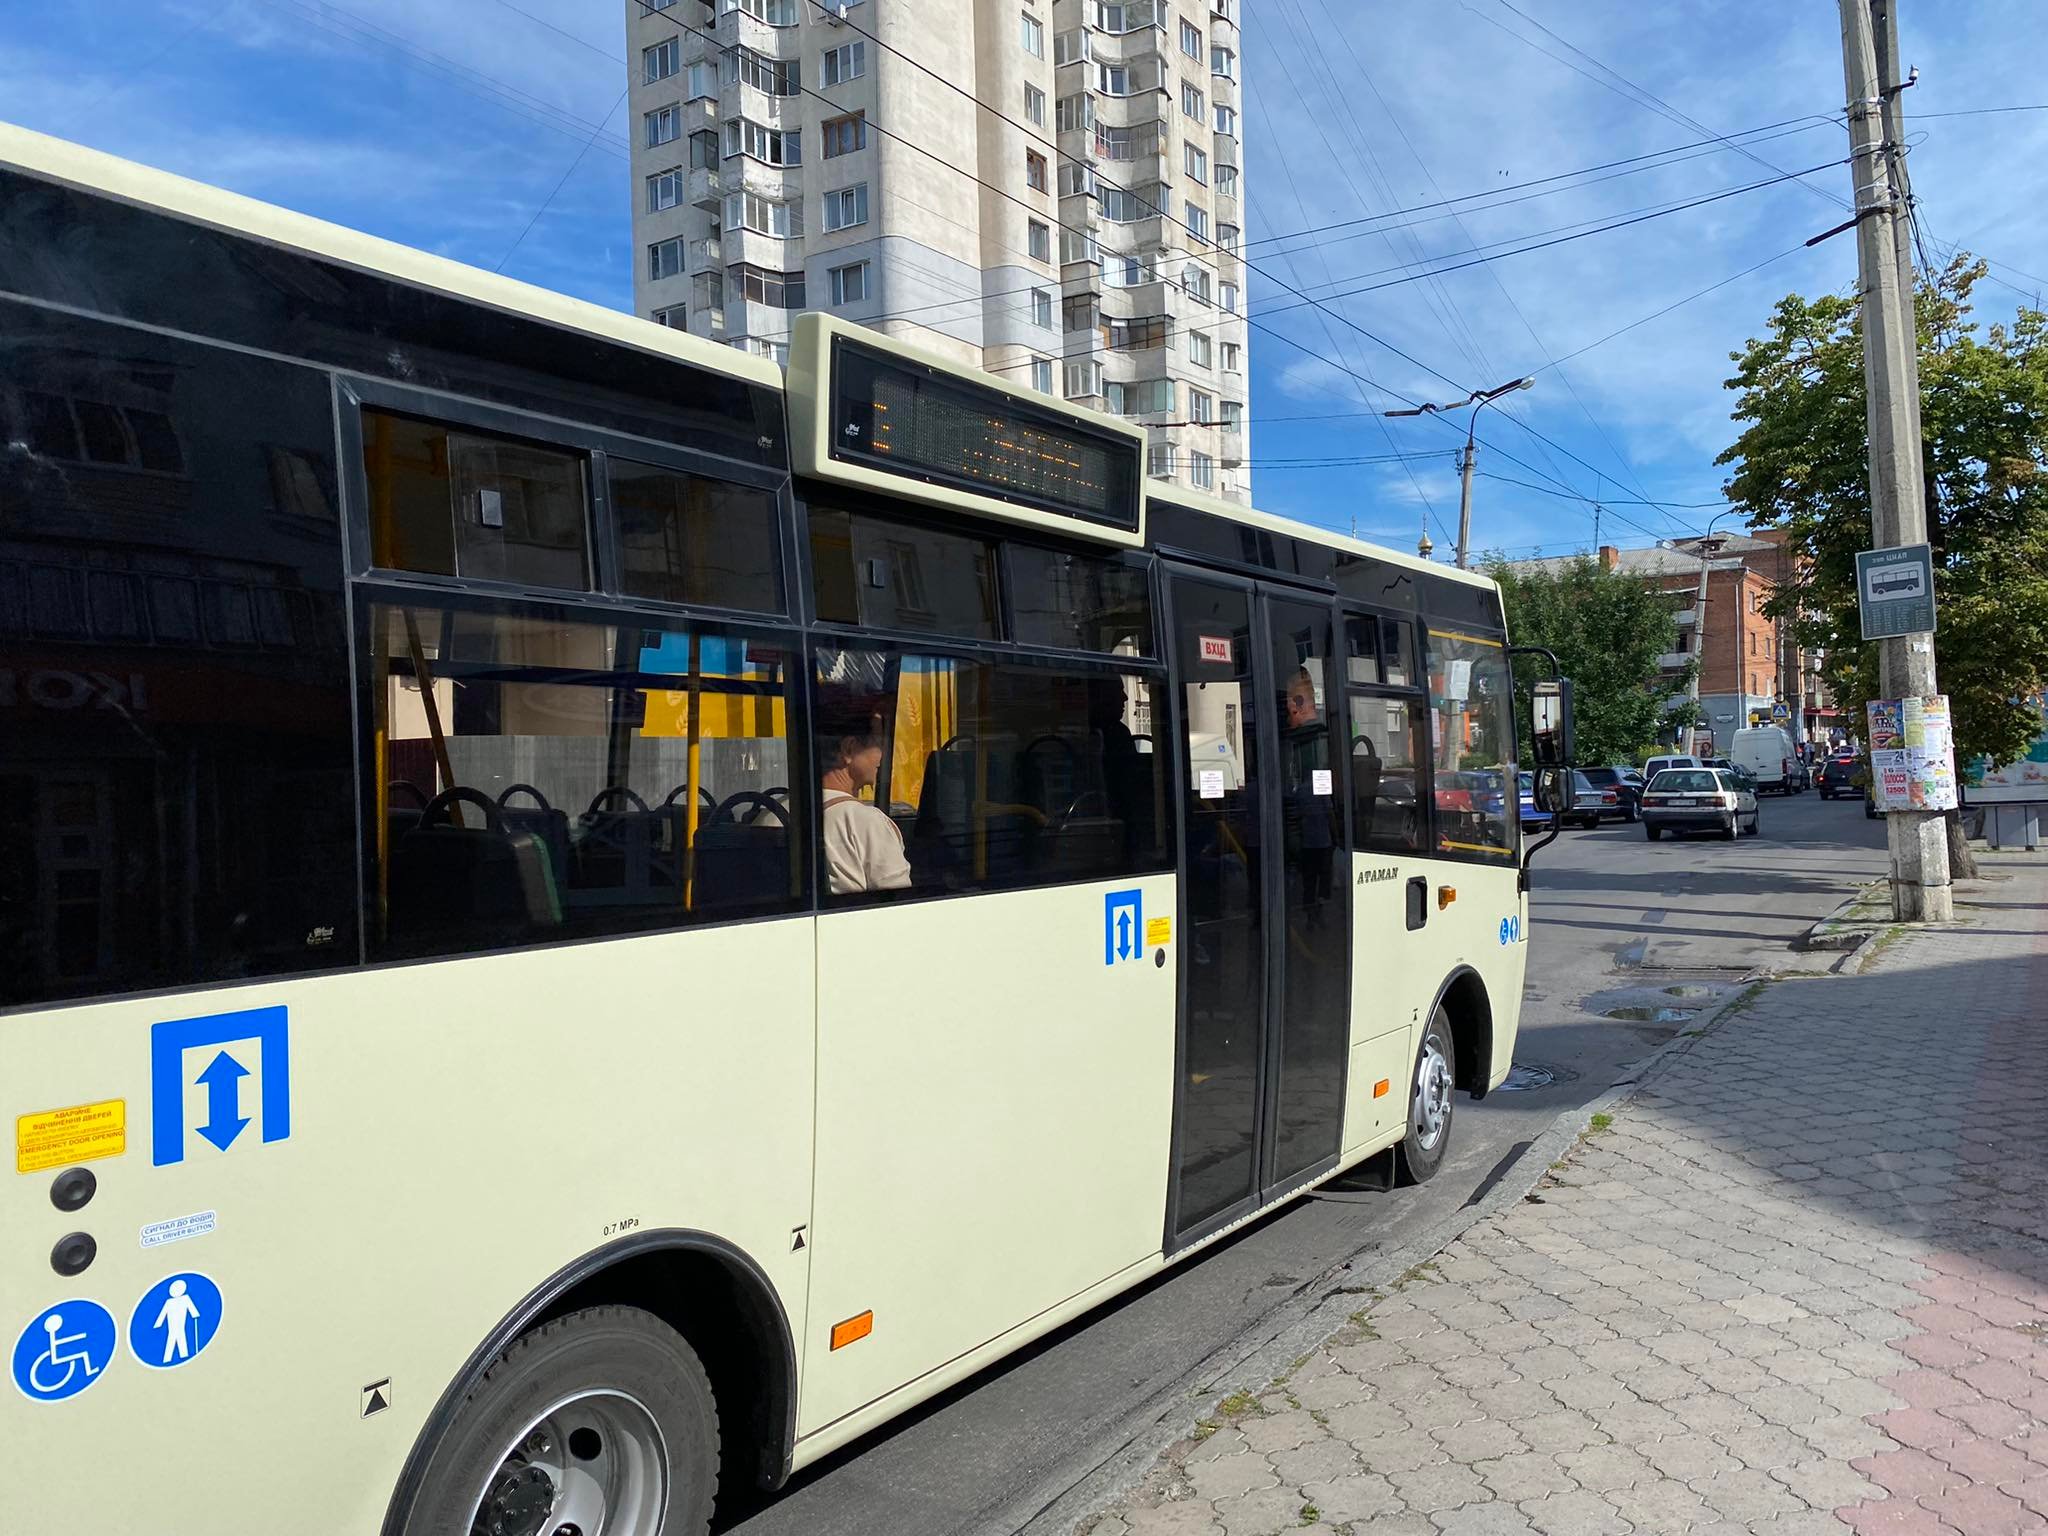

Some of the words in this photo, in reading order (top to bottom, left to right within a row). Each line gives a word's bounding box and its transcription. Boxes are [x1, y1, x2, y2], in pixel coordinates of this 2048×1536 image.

[1205, 642, 1227, 658] ВХІД
[1357, 867, 1399, 884] ATAMAN
[20, 1141, 67, 1155] EMERGENCY
[68, 1136, 91, 1146] DOOR
[92, 1130, 124, 1142] OPENING
[144, 1222, 176, 1235] СИГНАЛ
[176, 1219, 189, 1228] ДО
[144, 1235, 161, 1244] CALL
[162, 1229, 187, 1240] DRIVER
[187, 1223, 212, 1234] BUTTON
[603, 1223, 617, 1236] 0.7
[619, 1218, 639, 1231] MPa
